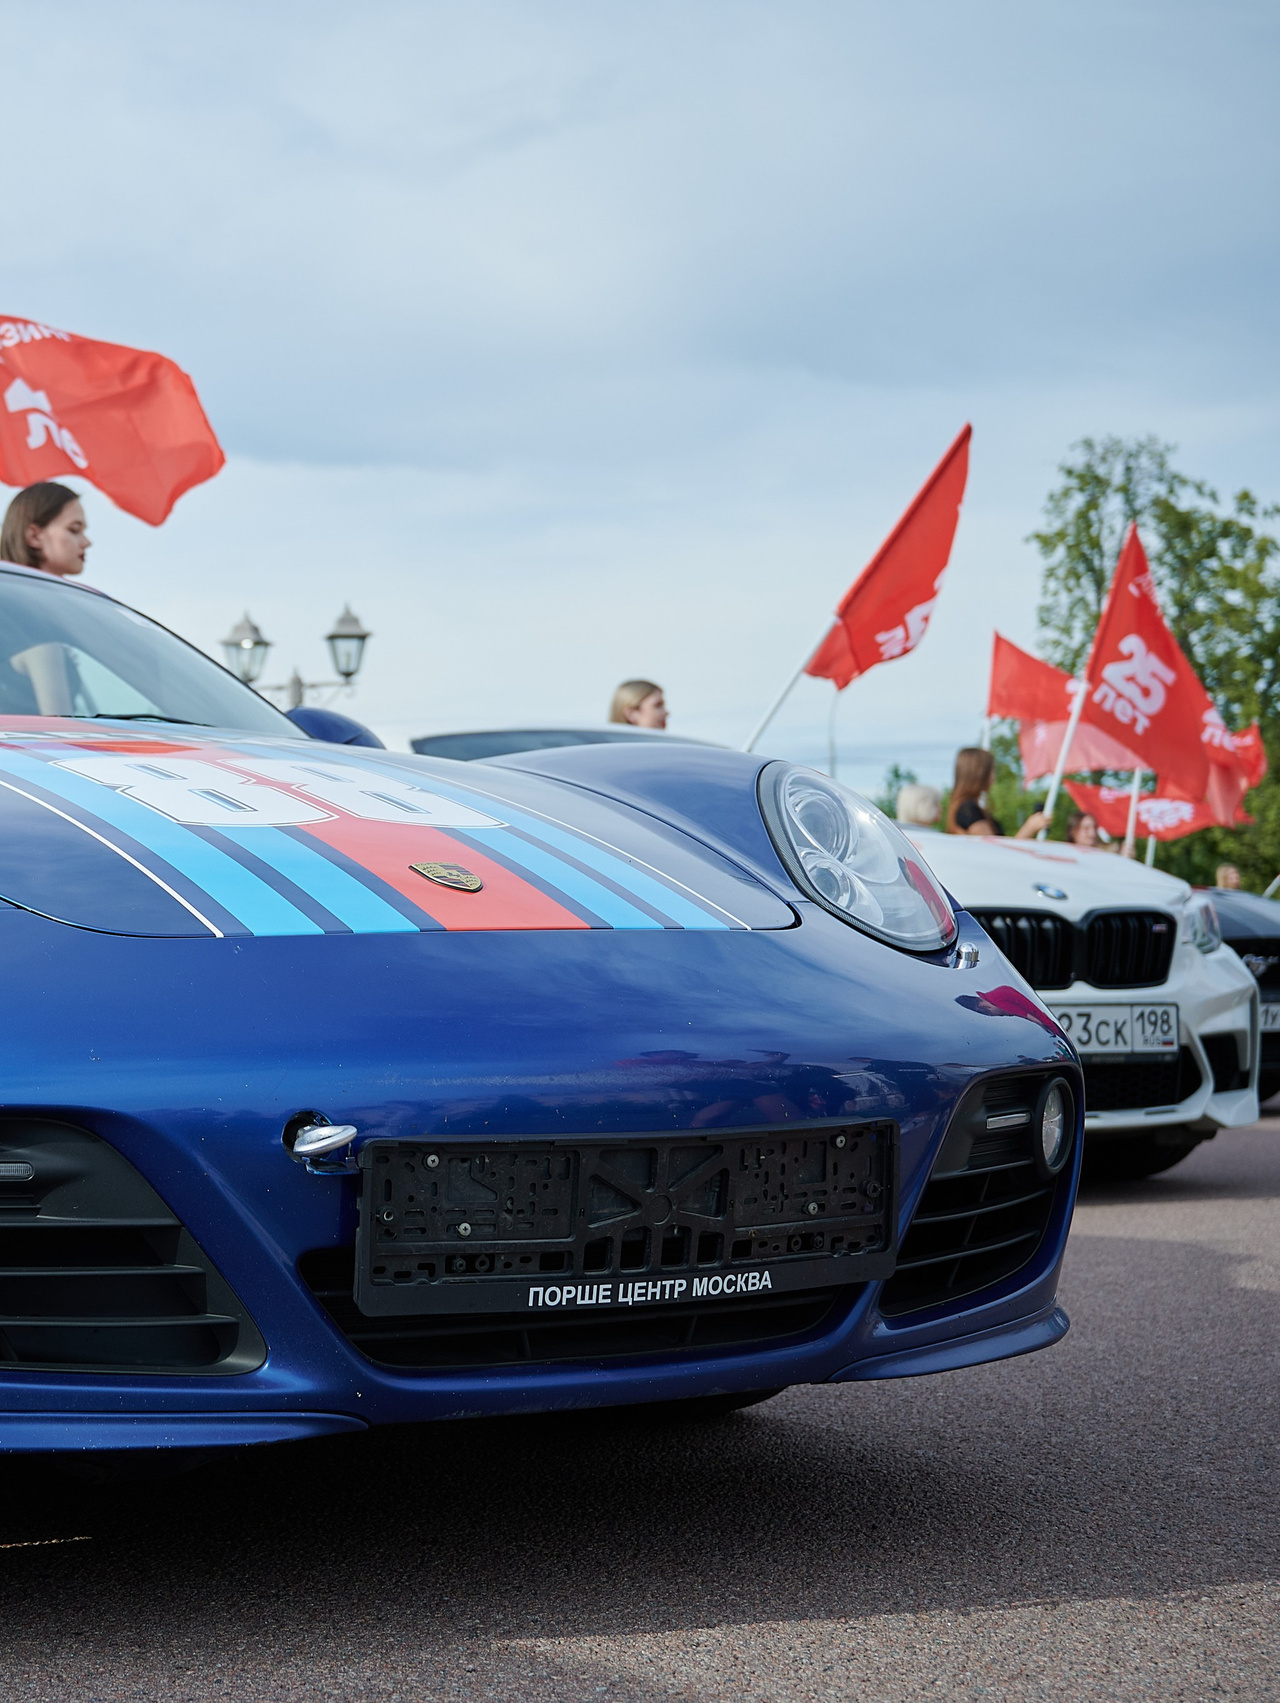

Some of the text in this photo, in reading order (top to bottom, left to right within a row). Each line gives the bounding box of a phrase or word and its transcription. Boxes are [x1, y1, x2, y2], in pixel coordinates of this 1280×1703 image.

[1101, 633, 1176, 717] 25
[49, 757, 510, 828] 88
[1135, 1009, 1172, 1035] 198
[528, 1270, 773, 1306] ПОРШЕ ЦЕНТР МОСКВА
